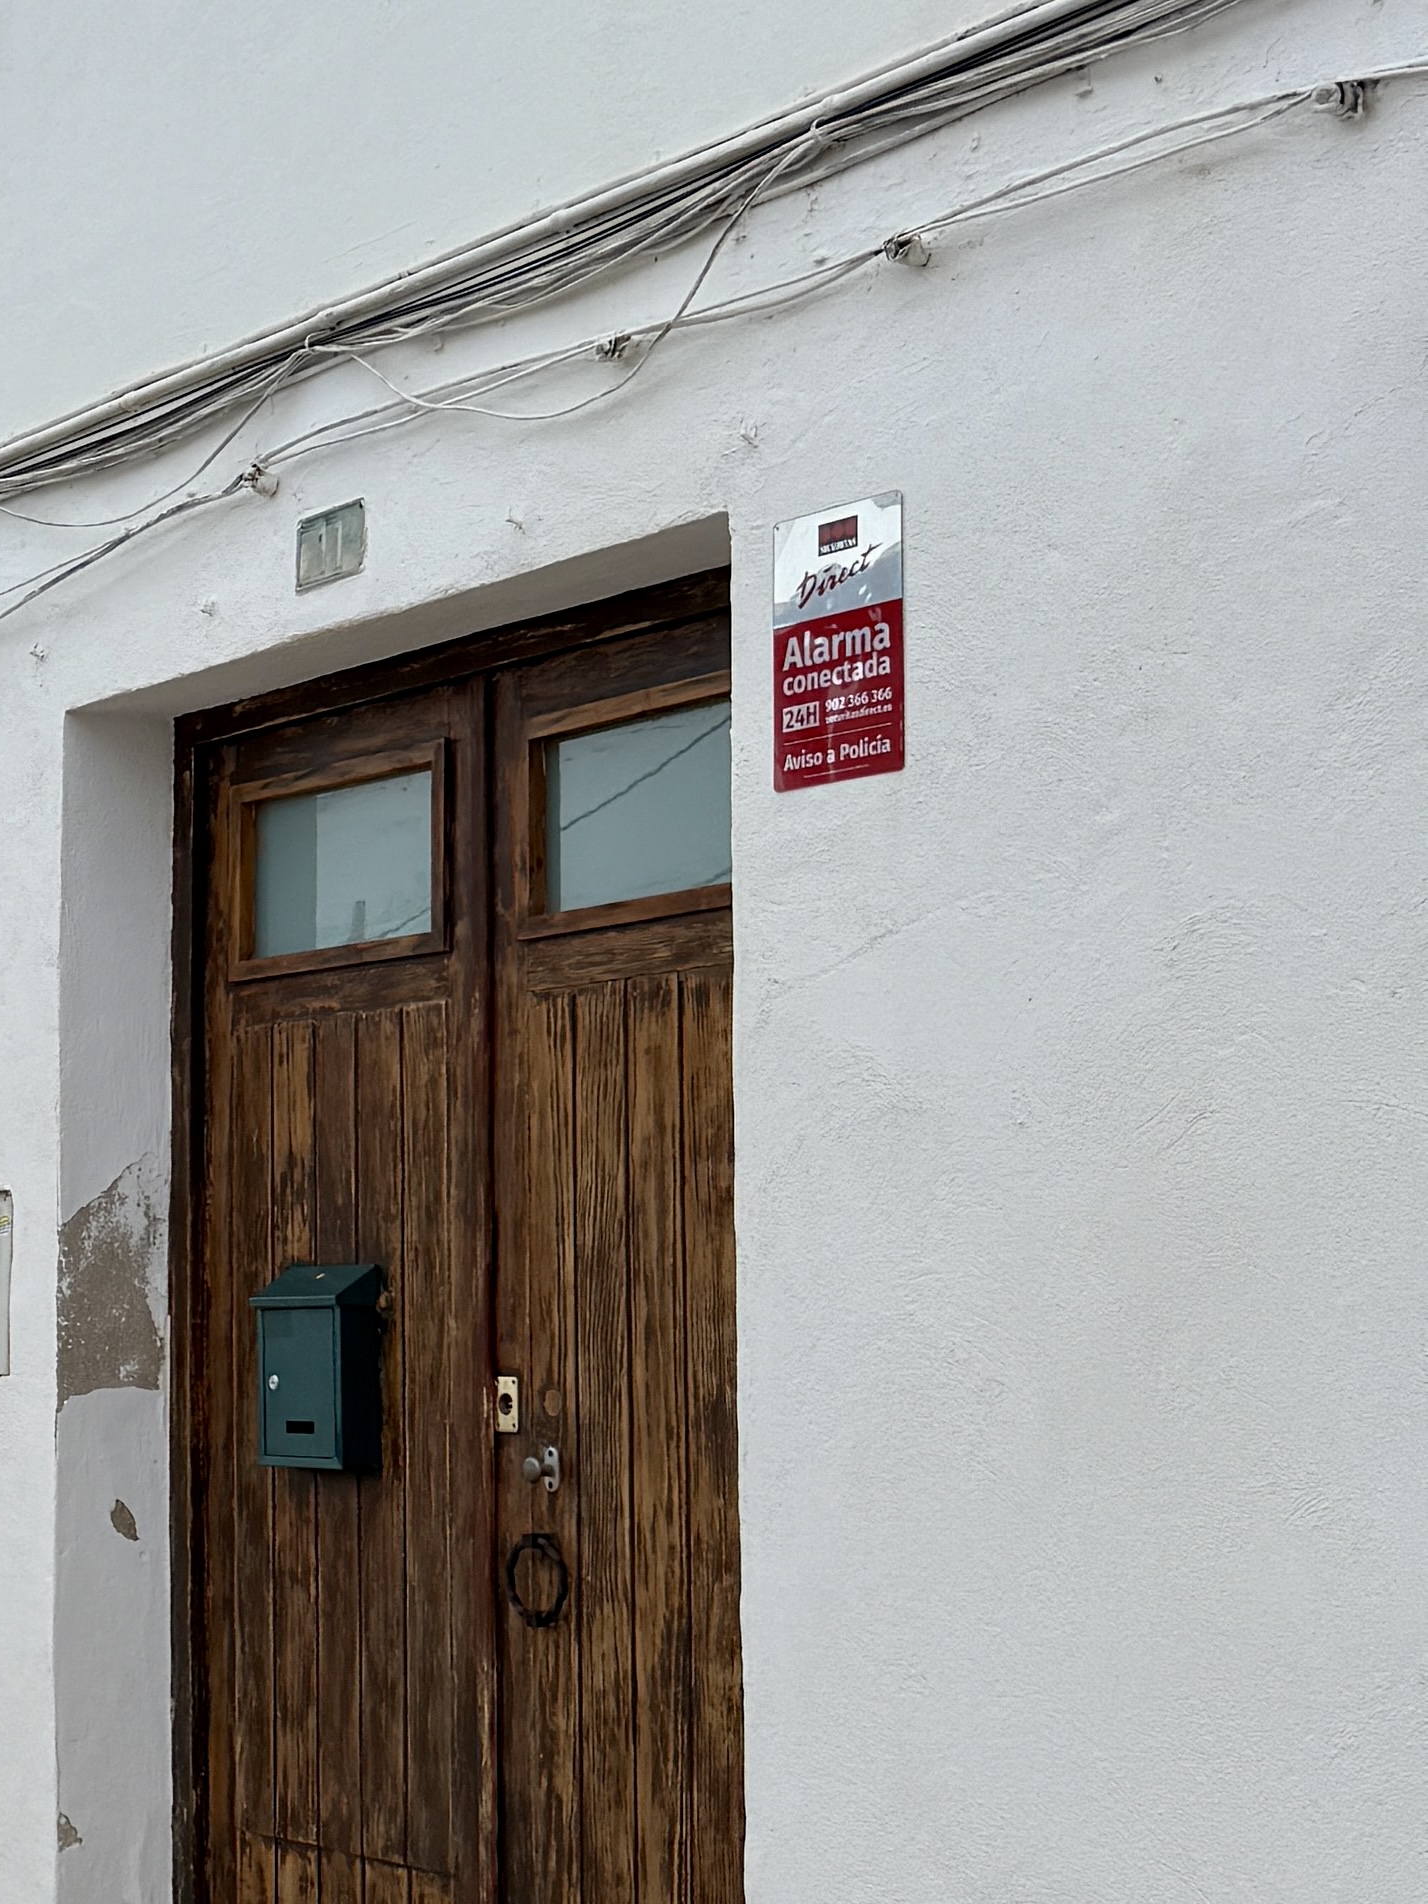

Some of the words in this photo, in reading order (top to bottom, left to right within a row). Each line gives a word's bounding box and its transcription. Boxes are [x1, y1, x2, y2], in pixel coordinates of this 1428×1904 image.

[796, 543, 883, 609] Direct
[782, 622, 891, 671] Alarma
[783, 651, 891, 696] conectada
[784, 704, 818, 729] 24H
[825, 696, 846, 712] 902
[848, 691, 869, 708] 366
[871, 686, 893, 703] 366
[783, 749, 823, 772] Aviso
[826, 749, 836, 764] a
[839, 734, 891, 761] Policía
